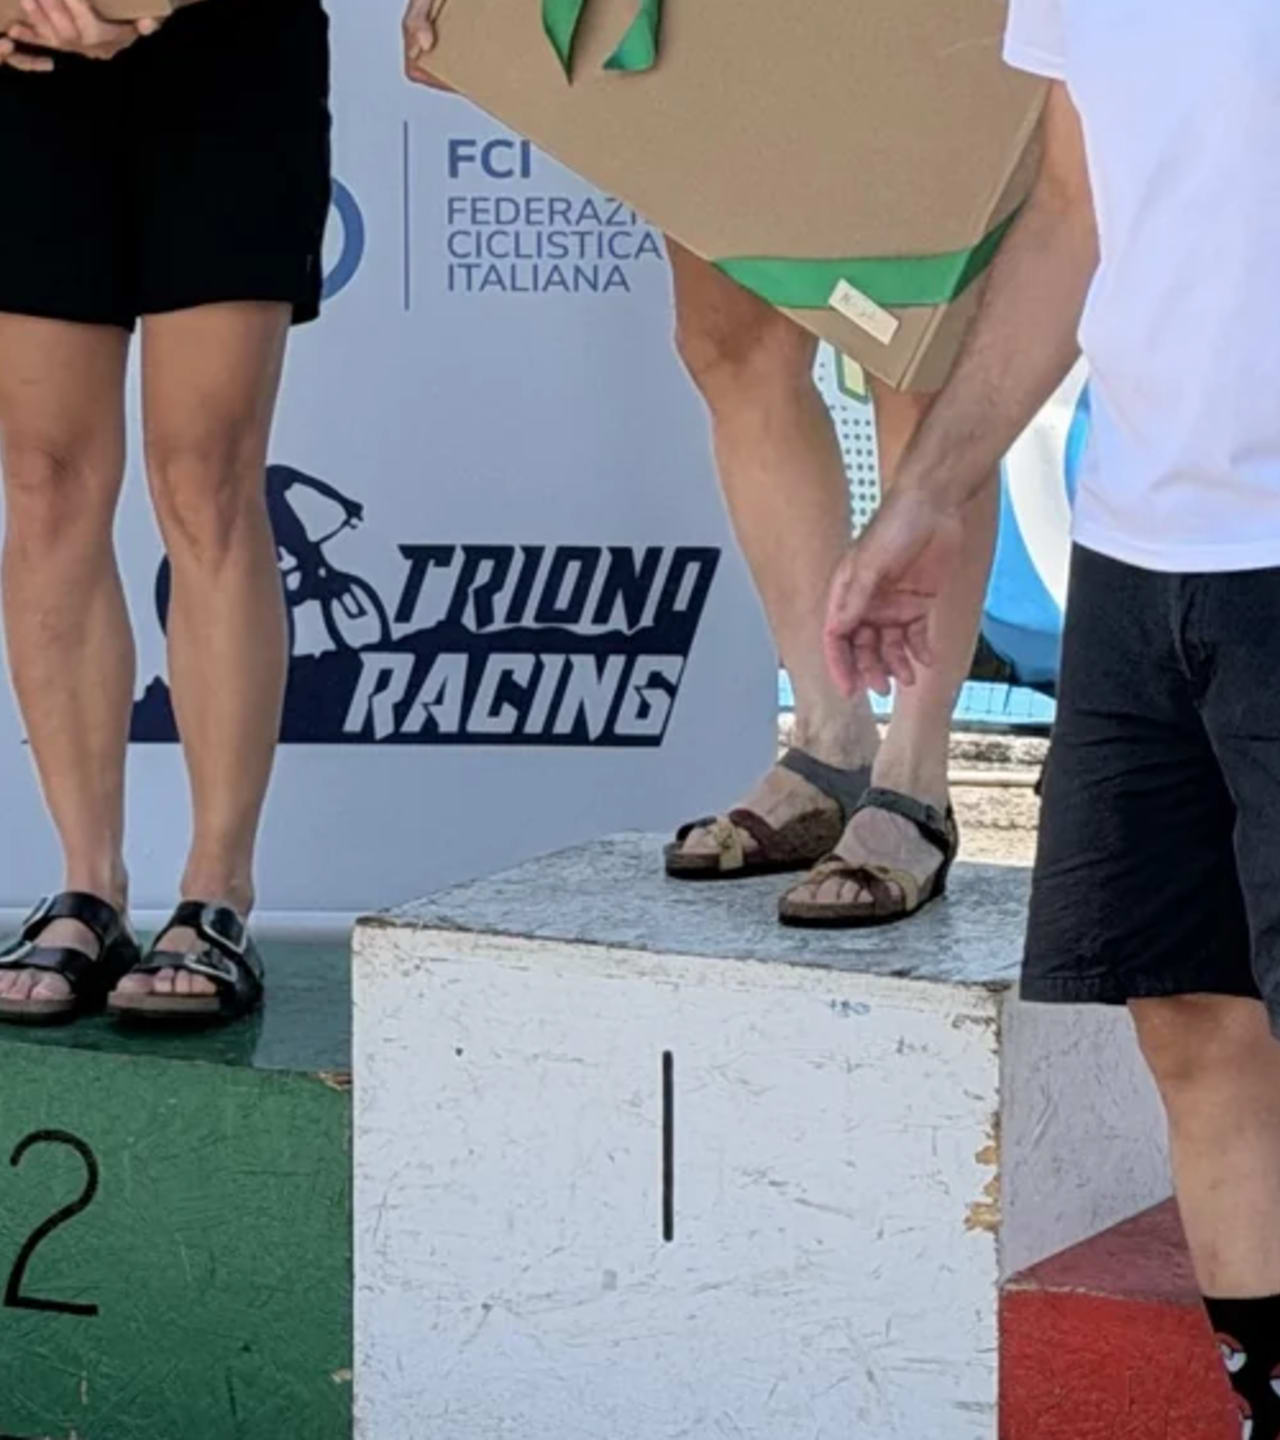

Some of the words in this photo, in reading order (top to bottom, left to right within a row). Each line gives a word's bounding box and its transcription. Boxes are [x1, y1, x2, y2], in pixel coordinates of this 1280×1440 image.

[447, 139, 531, 179] FCI
[447, 197, 650, 227] FEDERAZI
[447, 230, 664, 260] CICLISTICA
[448, 264, 631, 292] ITALIANA
[393, 544, 721, 633] TRIONO
[343, 652, 684, 740] RACING
[662, 1050, 674, 1243] 1
[4, 1128, 99, 1316] 2
